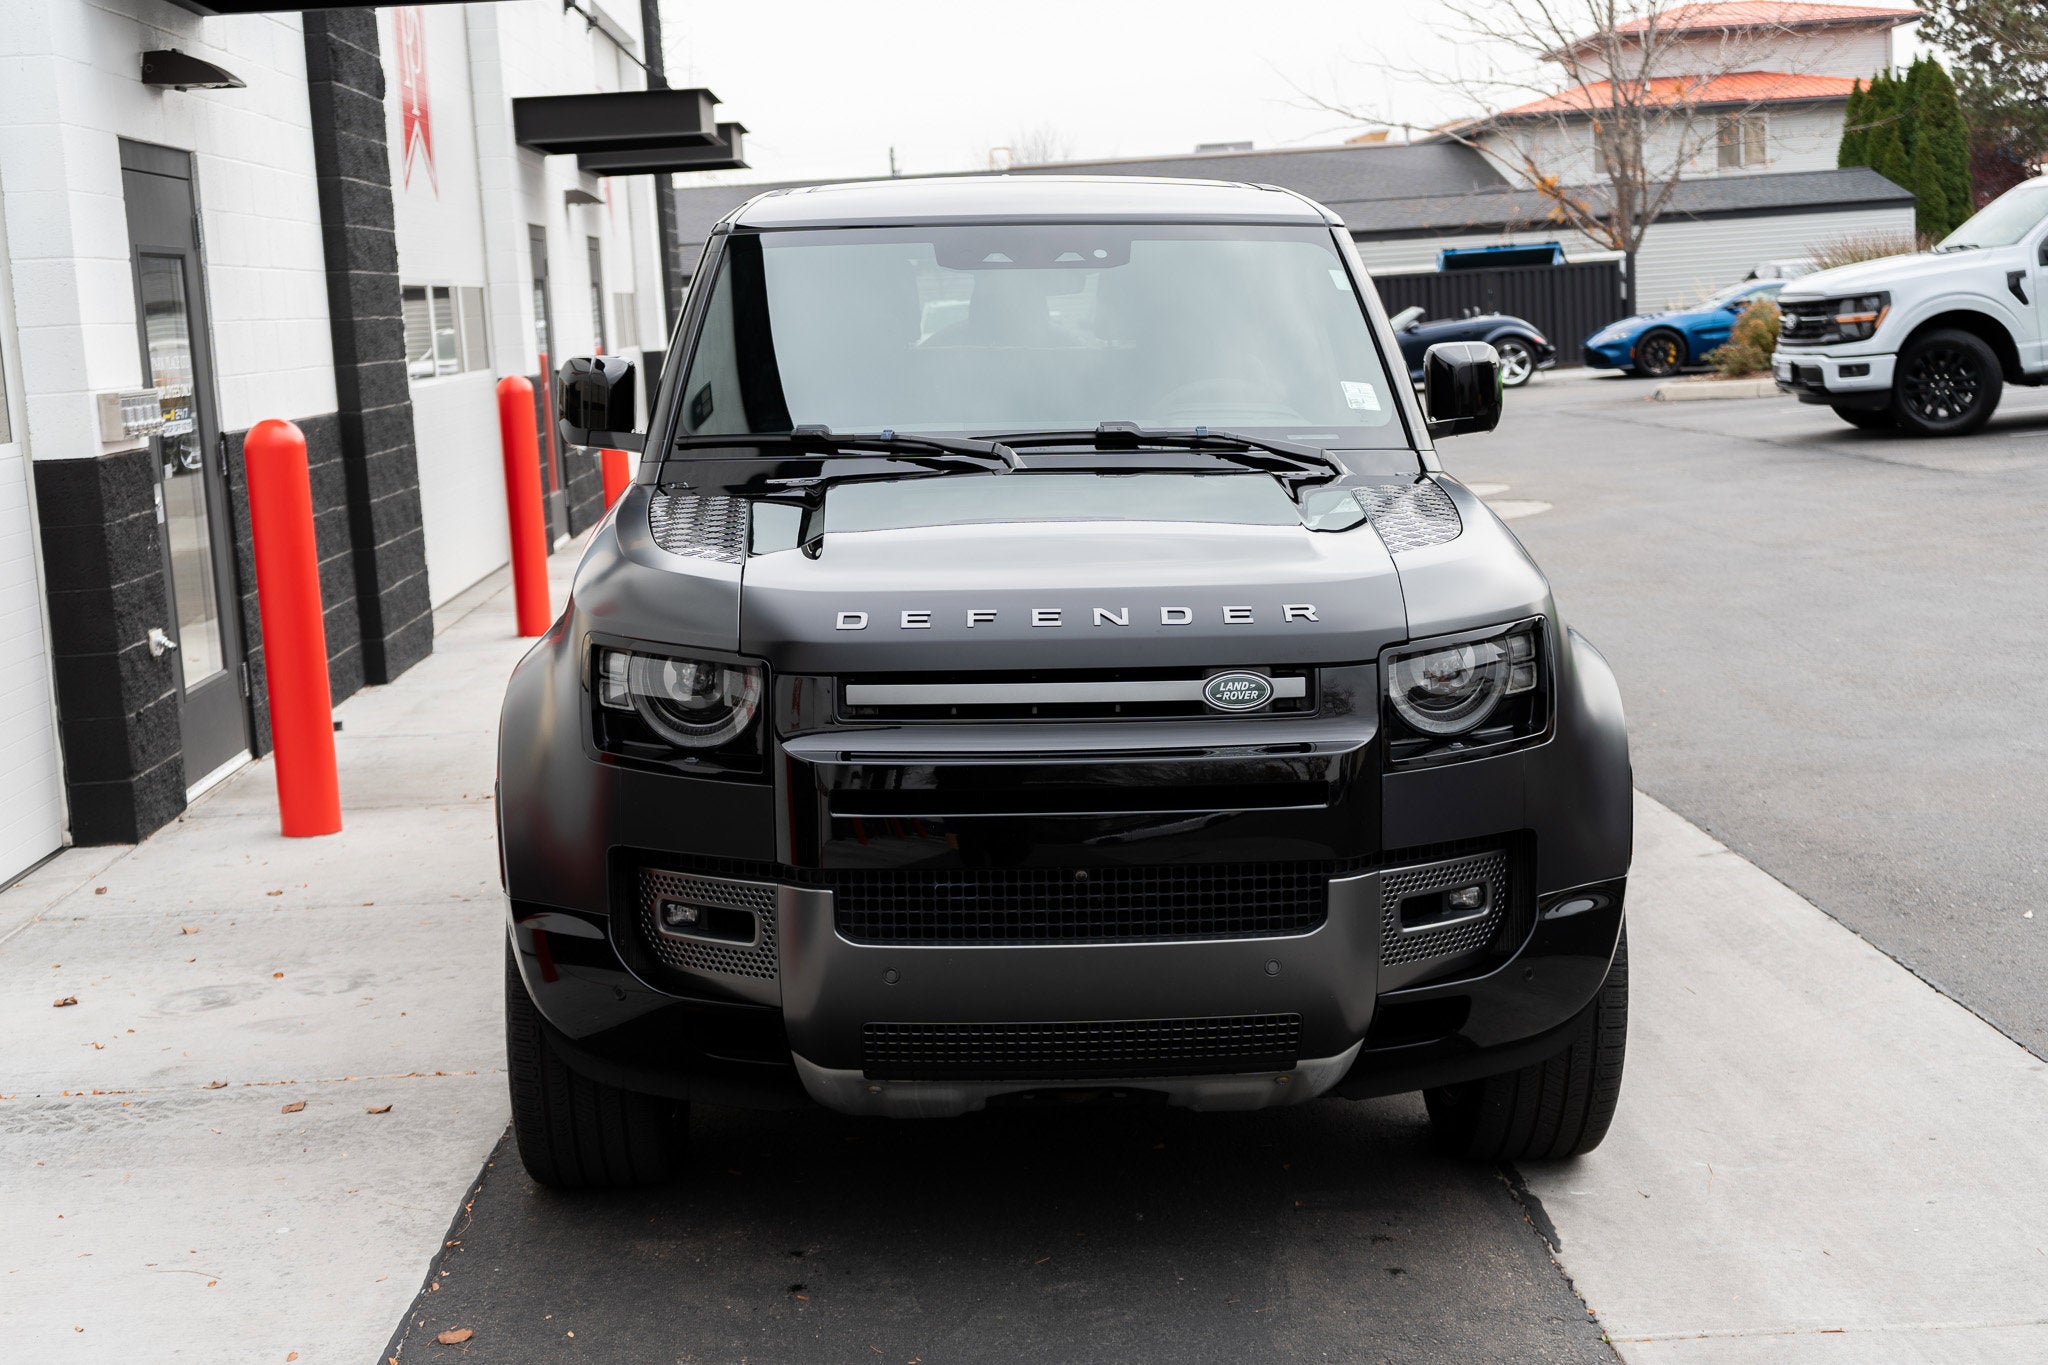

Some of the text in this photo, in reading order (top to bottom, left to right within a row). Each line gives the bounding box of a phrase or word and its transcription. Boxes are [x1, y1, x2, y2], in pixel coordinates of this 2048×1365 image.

[835, 603, 1320, 630] DEFENDER
[1220, 681, 1249, 691] LAND
[1222, 690, 1259, 700] ROVER
